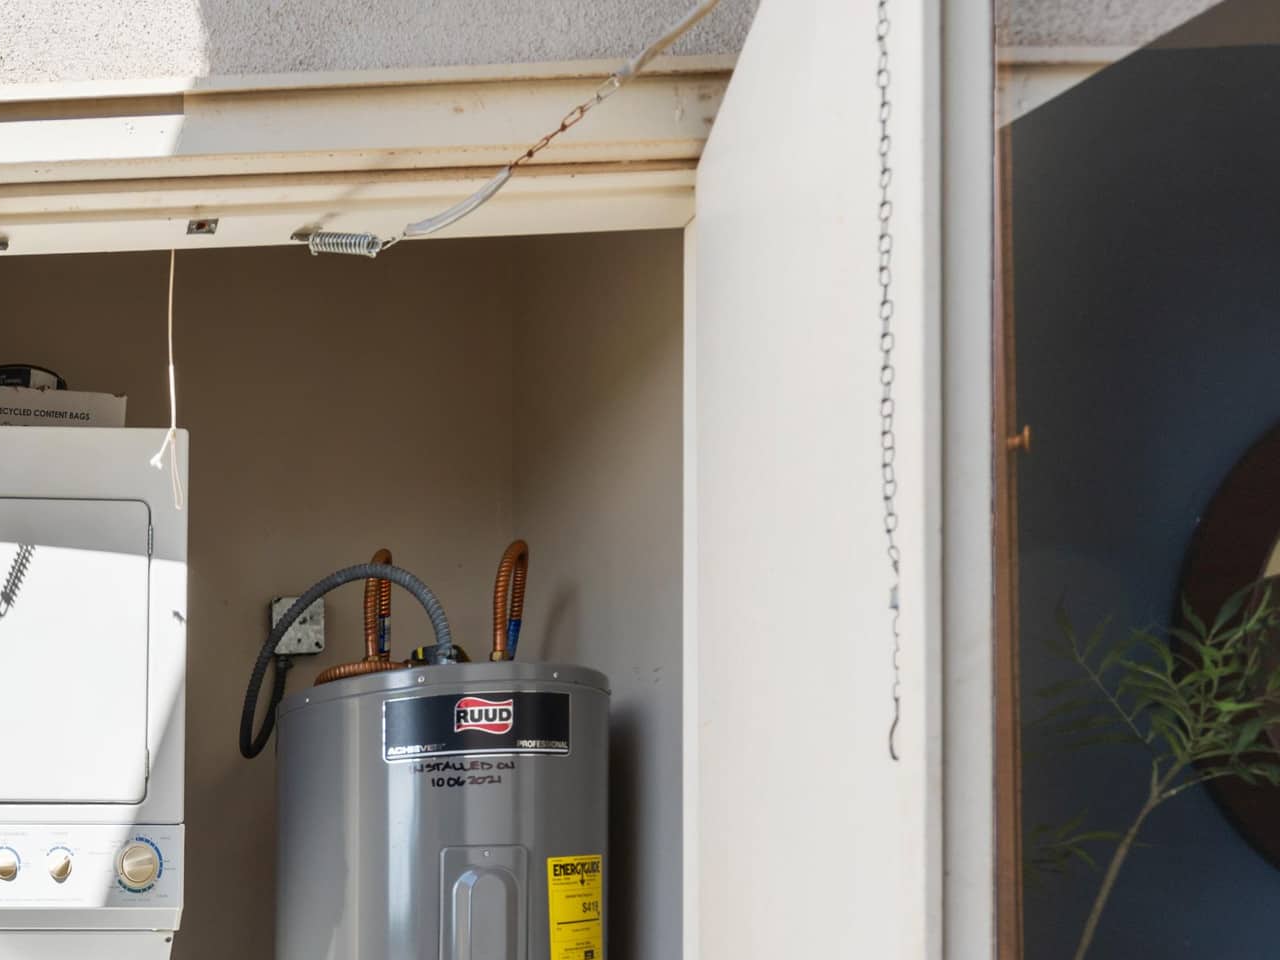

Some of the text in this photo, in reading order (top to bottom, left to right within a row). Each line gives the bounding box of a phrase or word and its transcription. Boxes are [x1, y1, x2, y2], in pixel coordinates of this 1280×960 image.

[33, 409, 67, 419] CONTENT
[69, 411, 90, 421] BAGS
[456, 708, 513, 724] RUUD
[410, 760, 516, 774] INSTALLED ON
